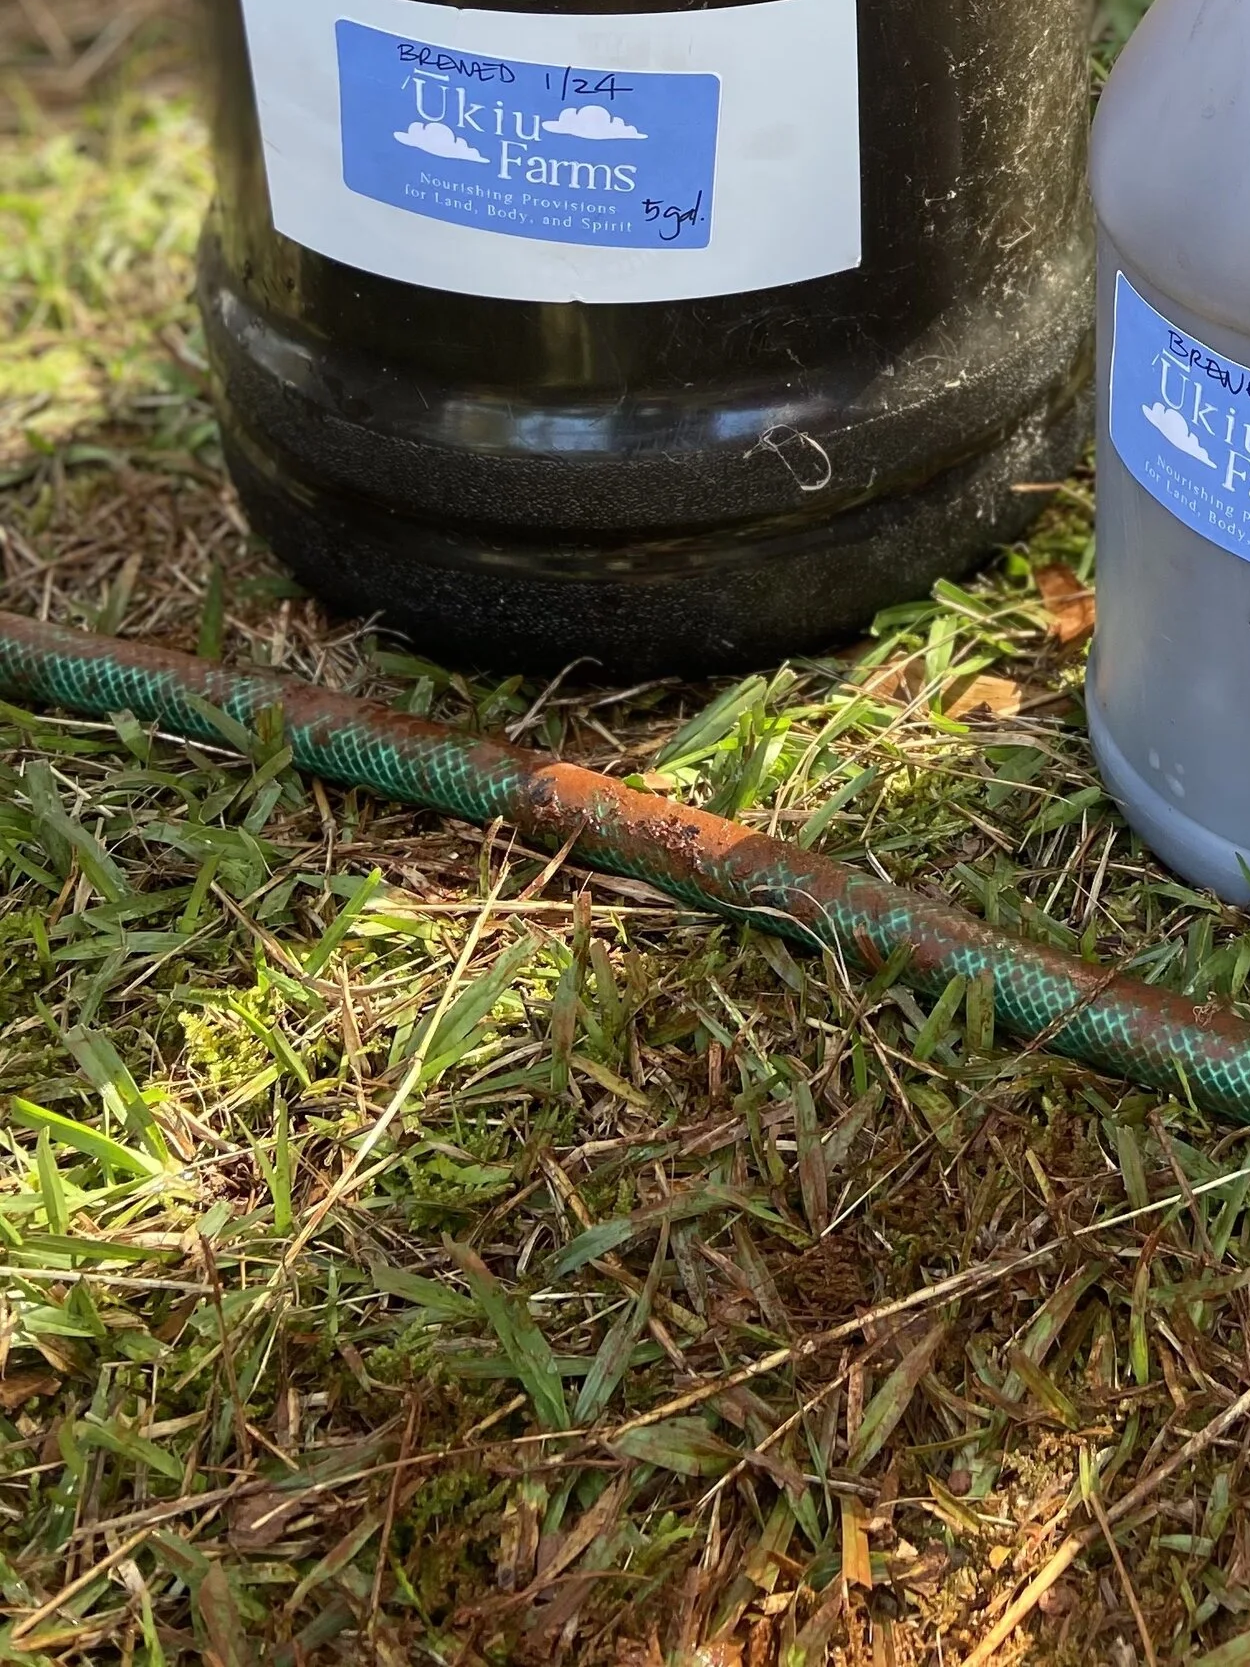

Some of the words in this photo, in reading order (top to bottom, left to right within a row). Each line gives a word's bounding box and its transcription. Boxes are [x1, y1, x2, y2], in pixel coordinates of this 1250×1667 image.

[398, 44, 515, 82] BREWED
[546, 66, 633, 101] 1/24
[498, 140, 637, 192] Farms
[405, 183, 427, 198] for
[435, 192, 478, 214] Land,
[488, 204, 533, 224] Body,
[543, 216, 572, 228] and
[582, 218, 632, 233] Spirit
[420, 172, 513, 204] Nourishing
[523, 193, 617, 215] Provisions
[1144, 460, 1161, 483] for
[1166, 480, 1202, 518] Land,
[1208, 510, 1250, 545] Body,
[1157, 454, 1235, 518] Nourishing
